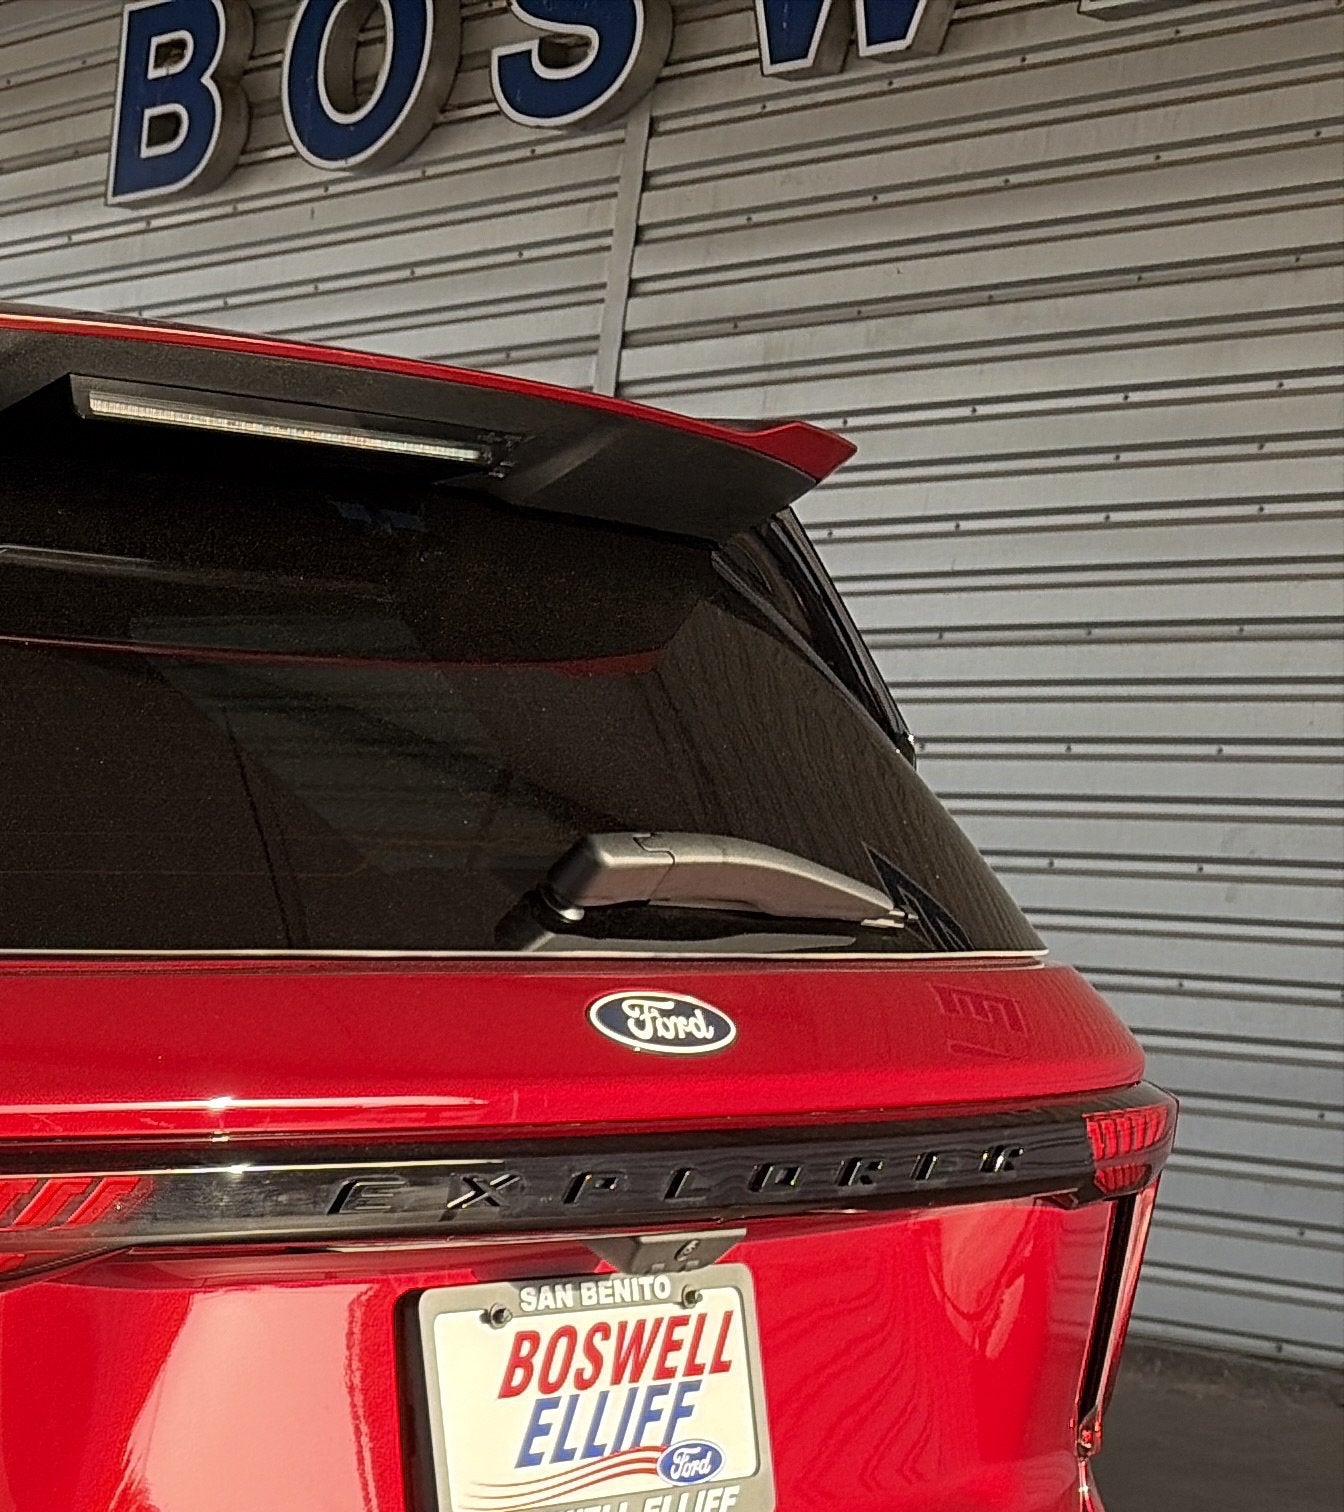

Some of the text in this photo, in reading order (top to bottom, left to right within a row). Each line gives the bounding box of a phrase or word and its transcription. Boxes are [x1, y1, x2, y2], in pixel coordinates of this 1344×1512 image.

[621, 999, 714, 1040] Ford
[326, 1145, 1024, 1216] EXPLORER
[520, 1276, 671, 1312] SAN BENITO
[497, 1310, 734, 1399] BOSWELL
[514, 1380, 702, 1469] ELLIFF
[669, 1449, 711, 1479] Ford
